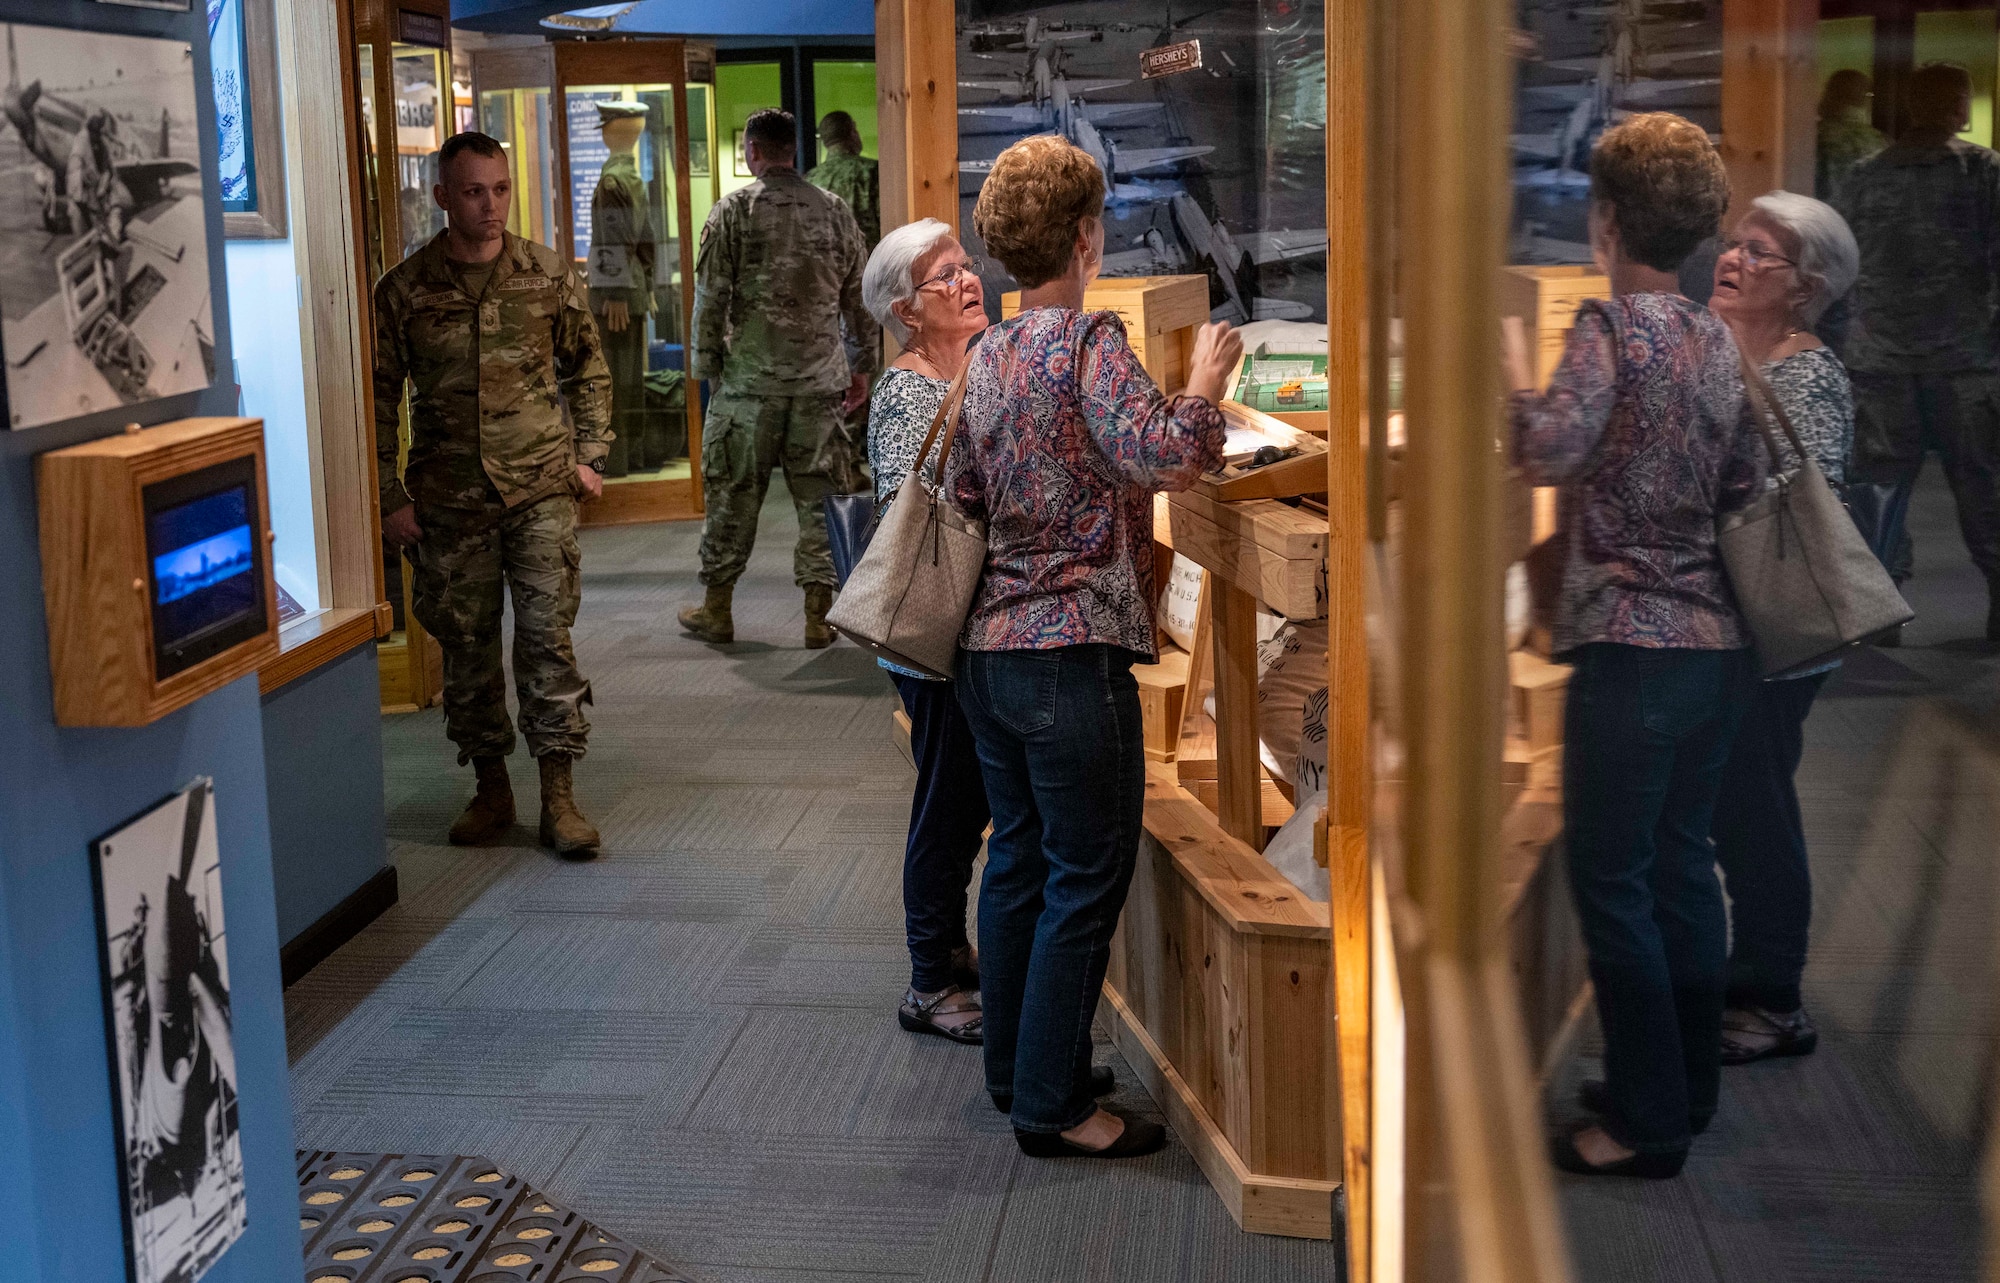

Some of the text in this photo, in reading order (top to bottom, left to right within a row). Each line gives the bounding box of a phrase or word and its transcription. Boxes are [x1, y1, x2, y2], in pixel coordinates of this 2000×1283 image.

[1149, 47, 1188, 67] HERSHEY'S
[512, 280, 523, 289] AIR
[524, 278, 545, 288] FORCE
